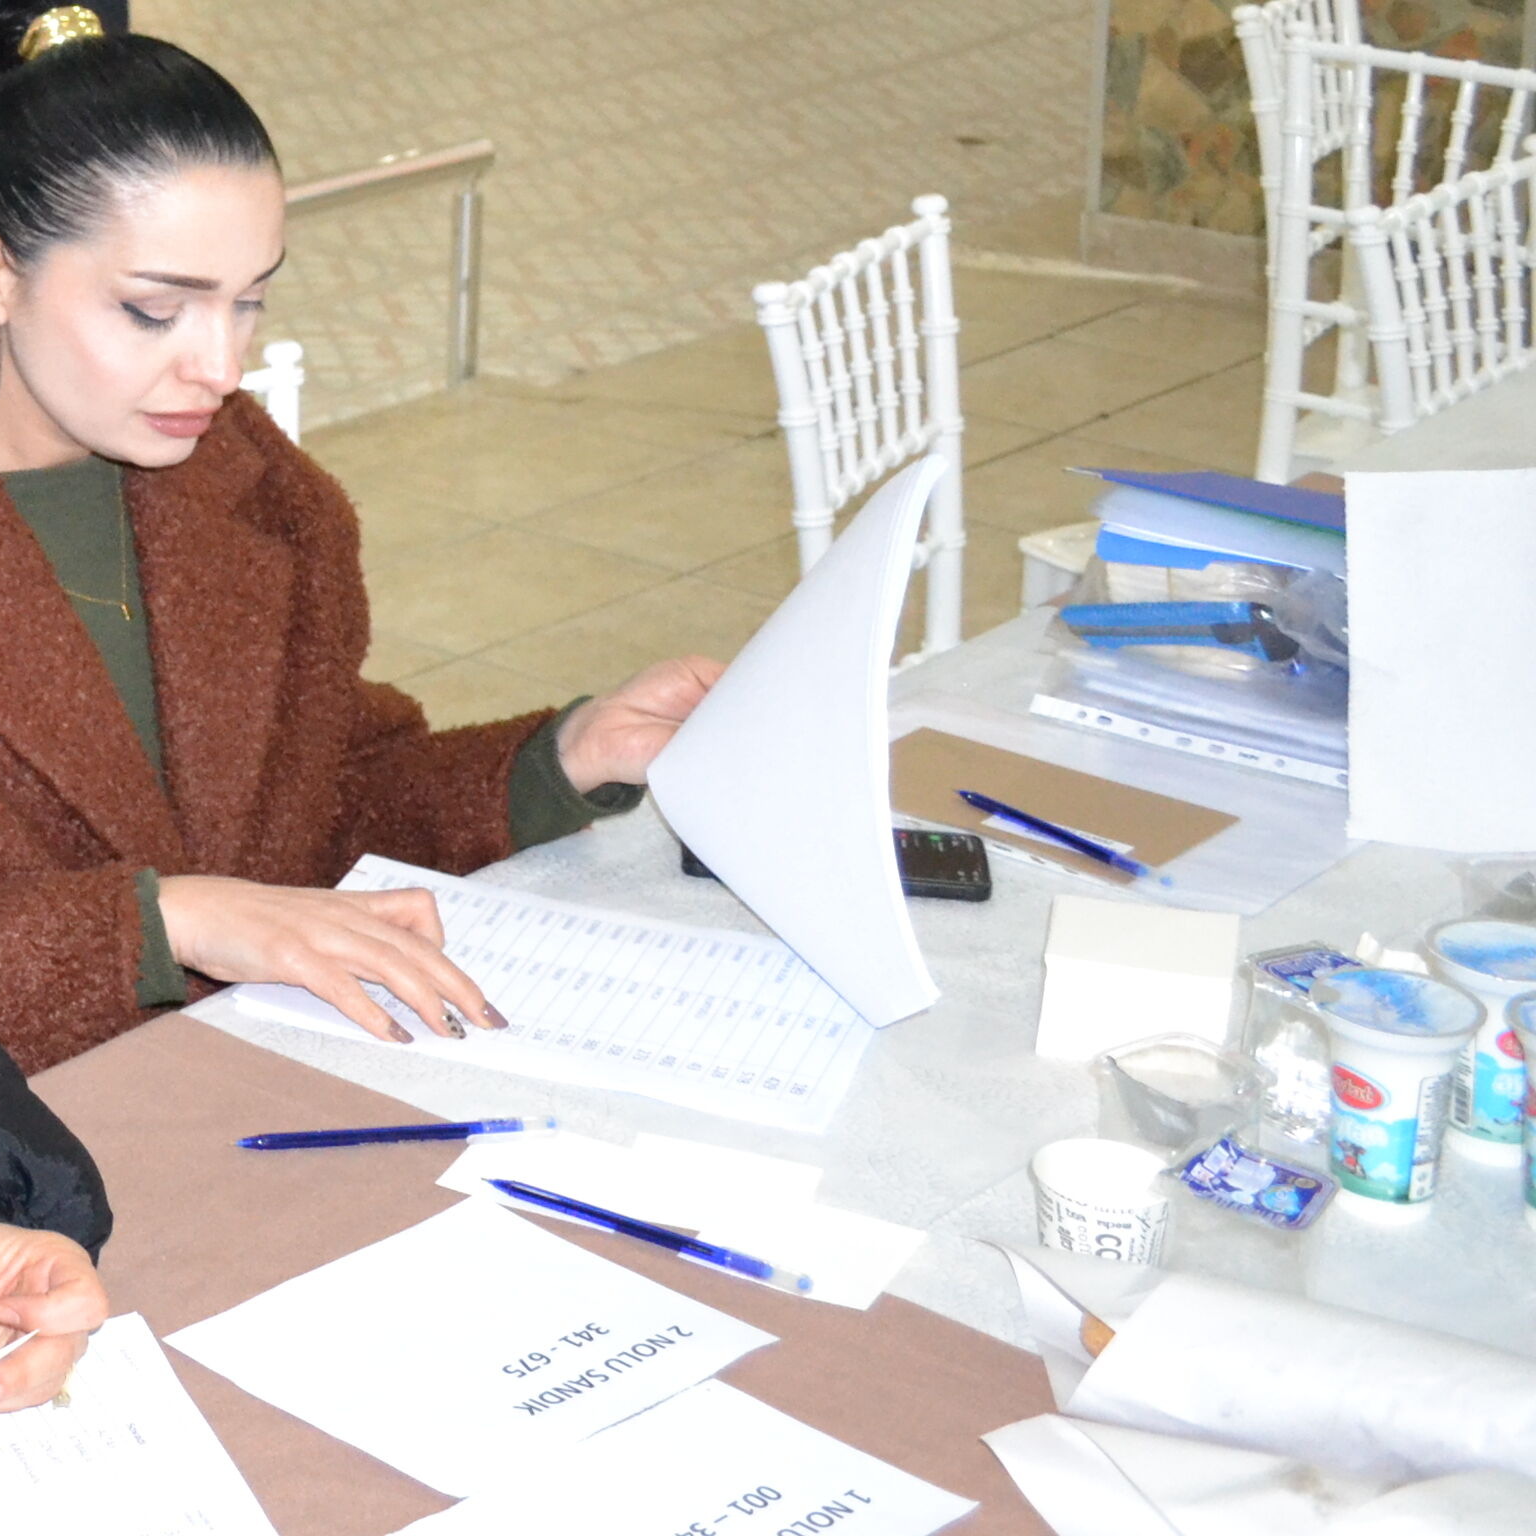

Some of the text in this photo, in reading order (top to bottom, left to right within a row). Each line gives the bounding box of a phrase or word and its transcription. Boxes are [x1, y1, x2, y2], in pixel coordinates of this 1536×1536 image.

[557, 1322, 611, 1348] 341
[501, 1351, 552, 1378] 675
[512, 1324, 694, 1417] 2 NOLU SANDIK
[726, 1485, 783, 1516] 001
[843, 1489, 872, 1505] 1
